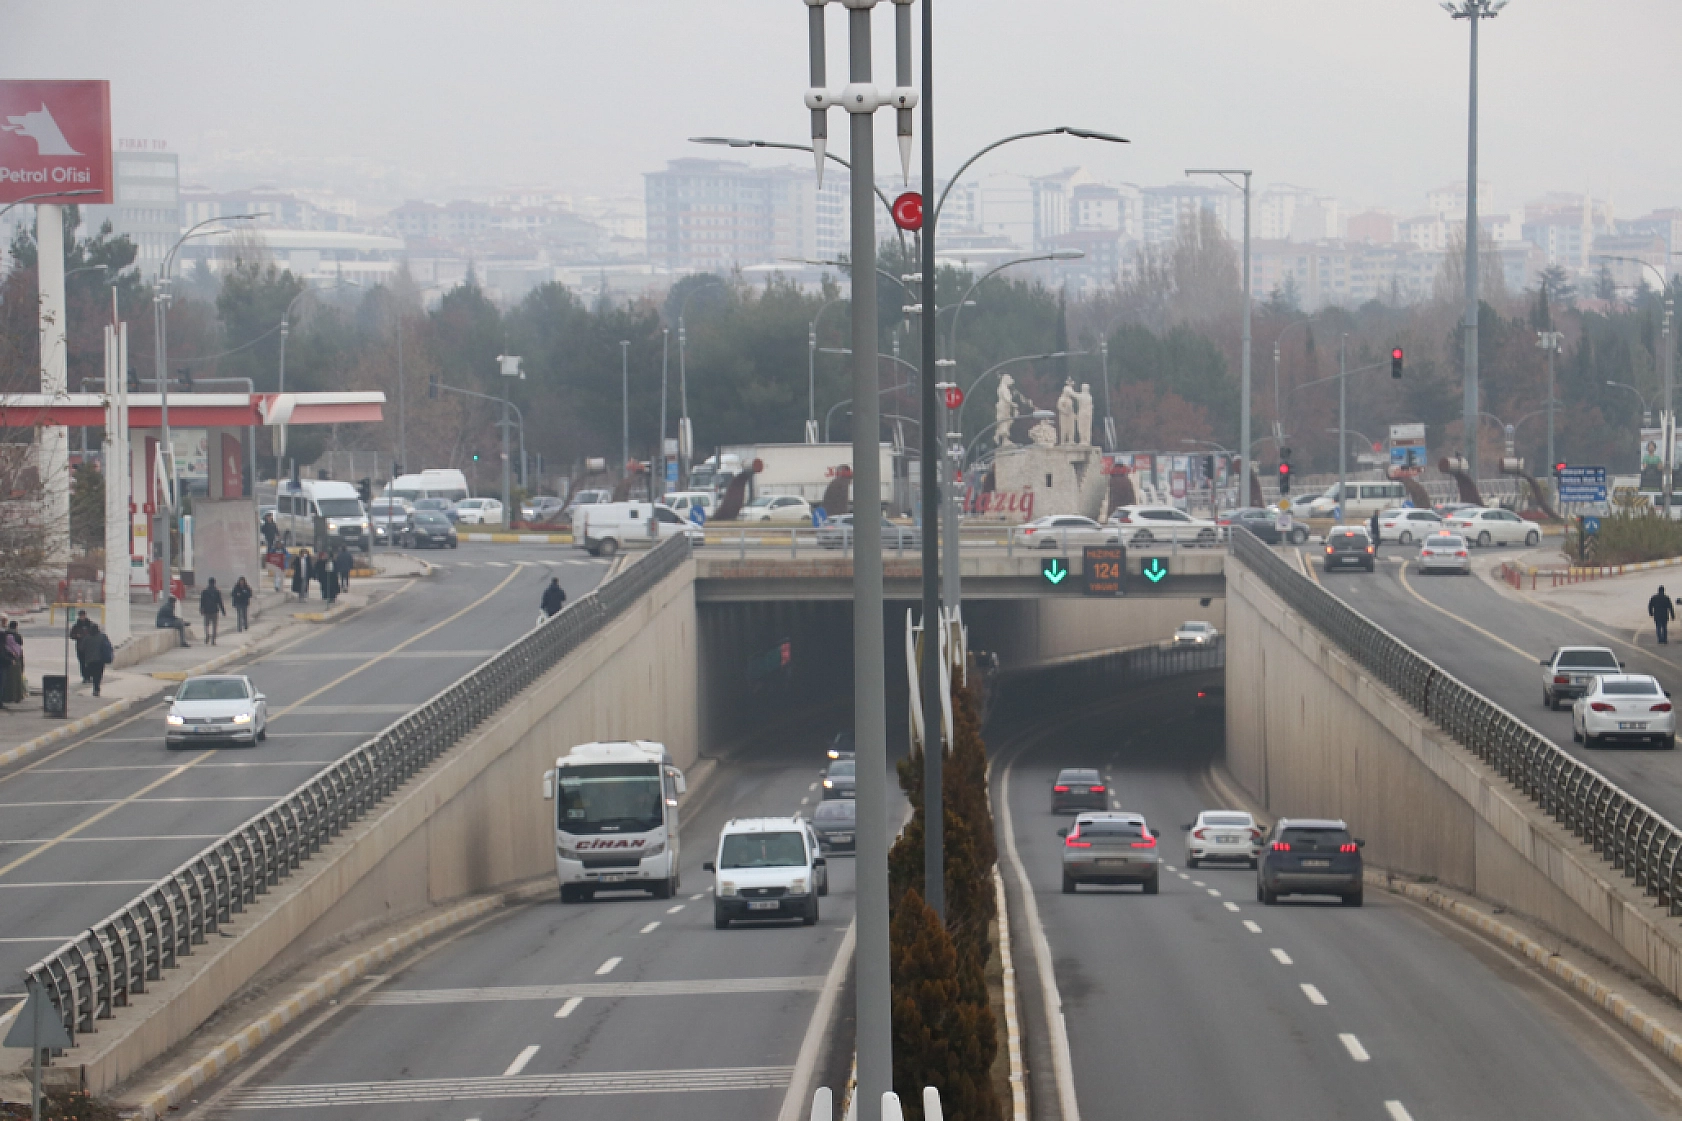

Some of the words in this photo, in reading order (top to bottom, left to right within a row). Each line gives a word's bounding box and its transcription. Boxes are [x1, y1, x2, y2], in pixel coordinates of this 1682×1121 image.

[0, 166, 48, 183] Petrol
[51, 166, 91, 183] Ofisi
[1093, 562, 1119, 579] 124
